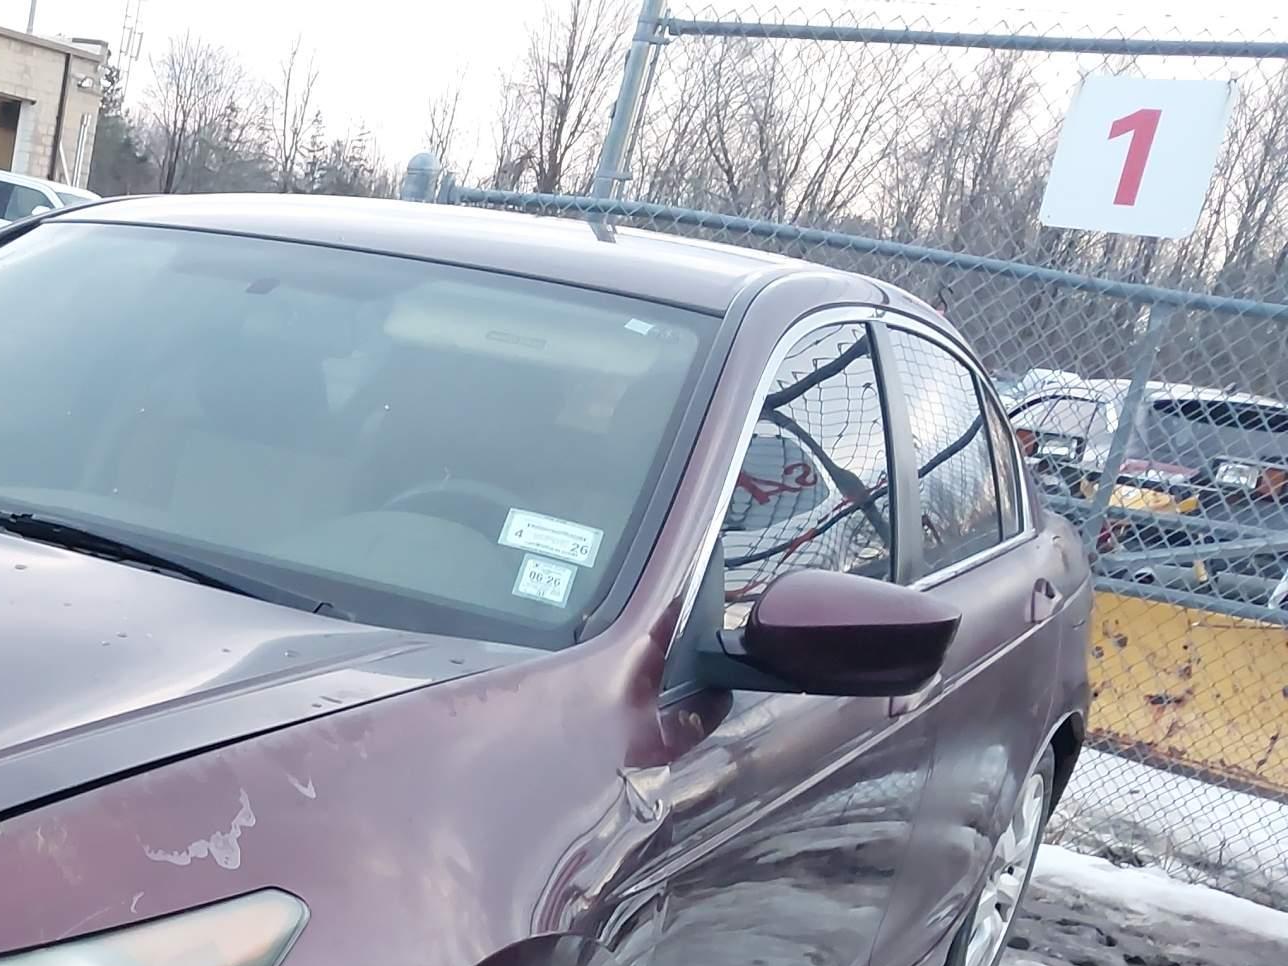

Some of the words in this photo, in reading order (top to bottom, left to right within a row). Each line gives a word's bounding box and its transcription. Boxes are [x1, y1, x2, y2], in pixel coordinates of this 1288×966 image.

[1108, 108, 1162, 206] 1
[515, 529, 524, 539] 4
[570, 542, 589, 556] 26
